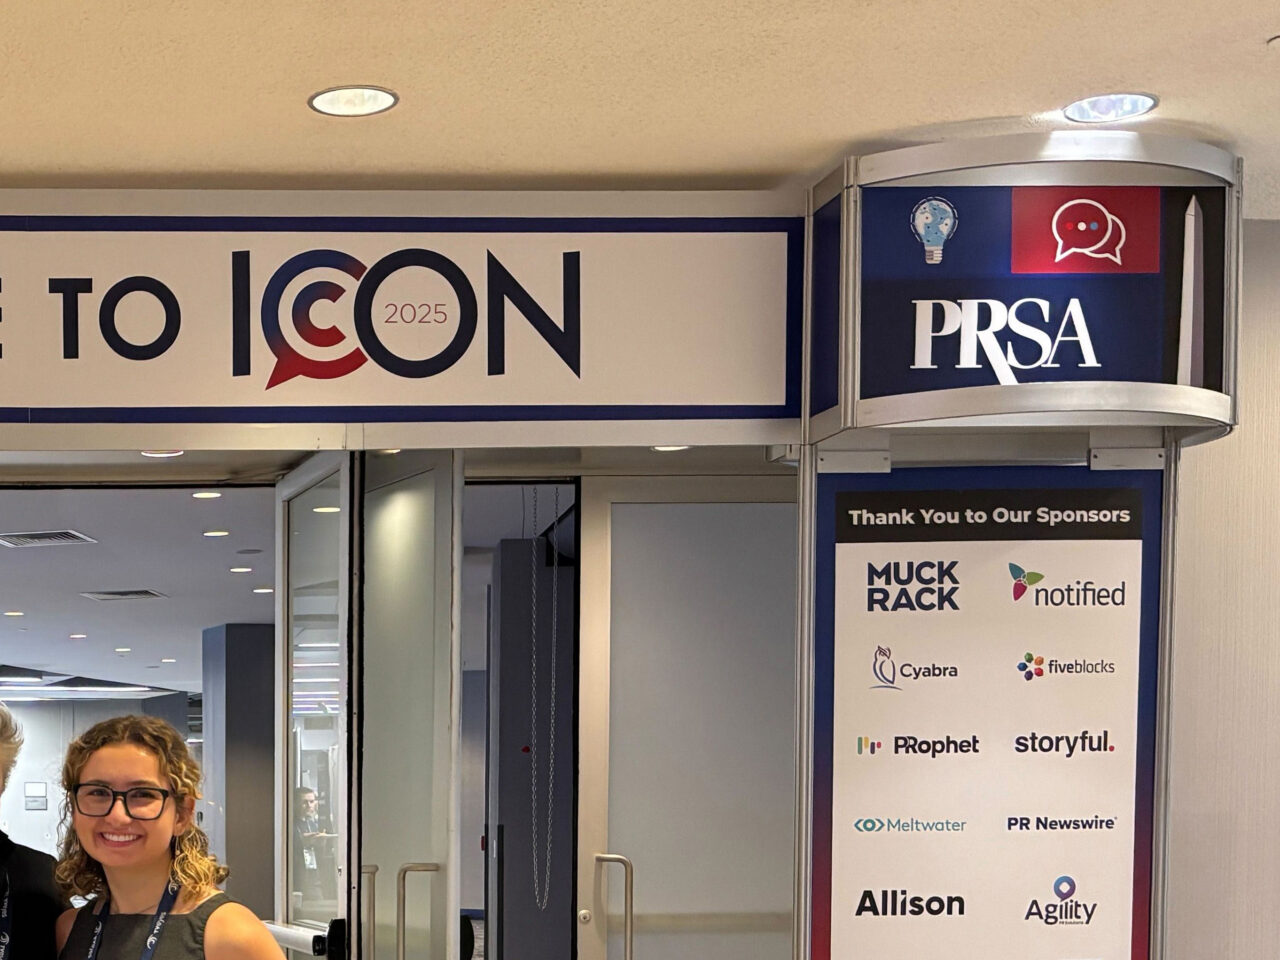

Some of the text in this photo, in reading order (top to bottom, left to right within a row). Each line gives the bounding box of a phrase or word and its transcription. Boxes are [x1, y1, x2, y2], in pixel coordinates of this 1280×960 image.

[48, 275, 181, 361] TO
[231, 247, 581, 390] ICON
[383, 303, 448, 325] 2025
[909, 297, 1102, 386] PRSA
[848, 507, 1131, 527] Thank You to Our Sponsors
[867, 561, 960, 586] MUCK
[867, 586, 960, 612] RACK
[1035, 581, 1126, 607] notified
[900, 663, 959, 680] Cyabra
[1048, 659, 1116, 674] fiveblocks
[894, 735, 980, 758] PRophet
[887, 818, 967, 832] Meltwater
[1007, 815, 1115, 831] PR Newswire
[855, 889, 965, 916] Allison
[1024, 899, 1097, 925] Agility
